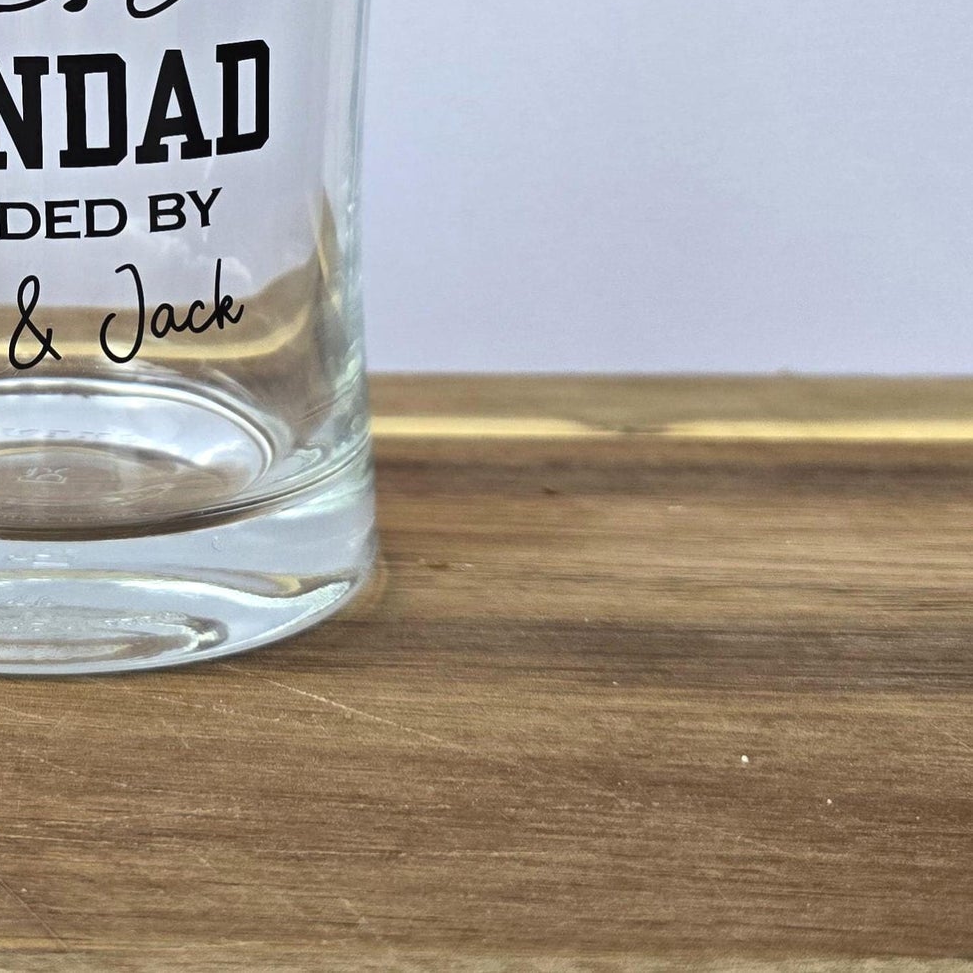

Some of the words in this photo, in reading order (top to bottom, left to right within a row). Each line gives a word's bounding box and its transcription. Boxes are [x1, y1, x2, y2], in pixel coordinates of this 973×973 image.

[147, 187, 222, 233] BY
[8, 274, 62, 371] &
[99, 258, 245, 364] Jack
